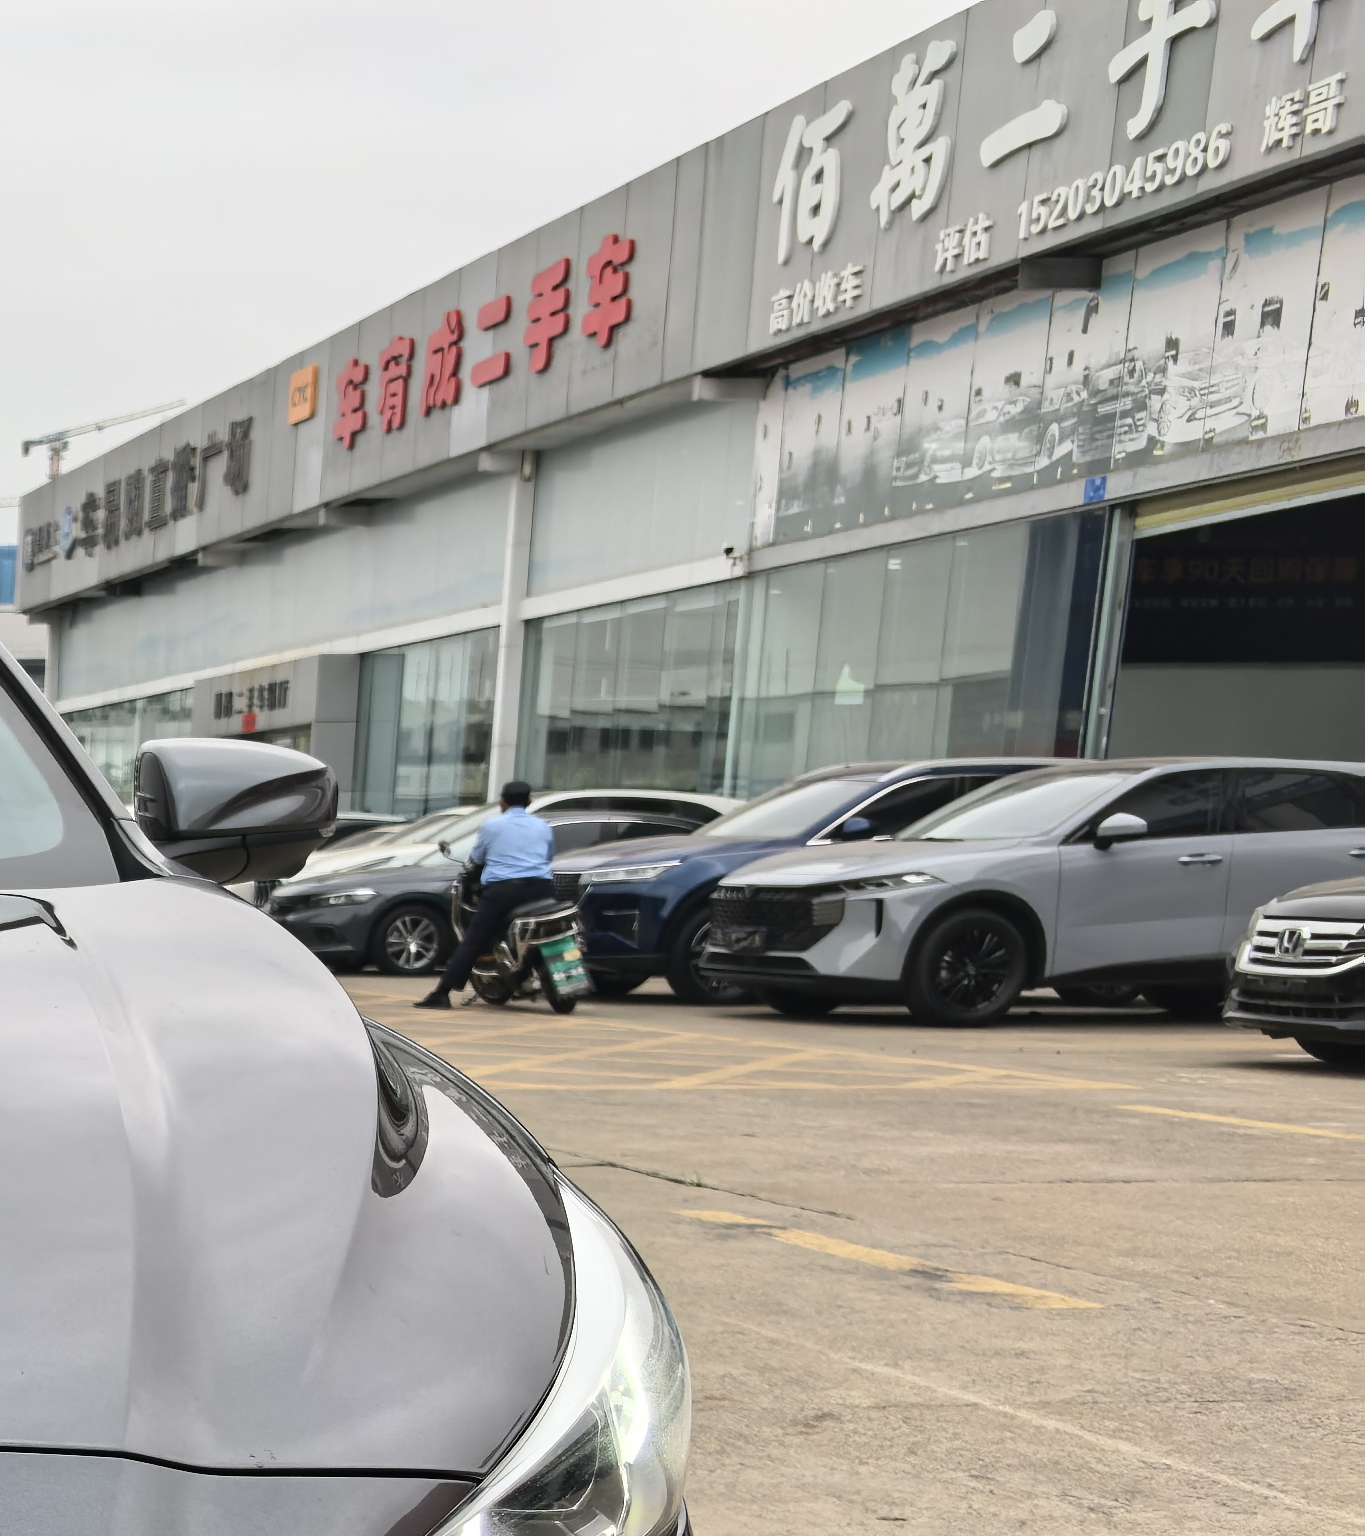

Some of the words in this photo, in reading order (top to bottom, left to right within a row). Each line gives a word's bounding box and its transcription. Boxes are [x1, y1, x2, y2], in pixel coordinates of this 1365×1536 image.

[769, 262, 865, 335] 高价收车
[934, 212, 994, 273] 评估
[1016, 122, 1233, 240] 15203045986
[1260, 72, 1347, 153] 辉哥
